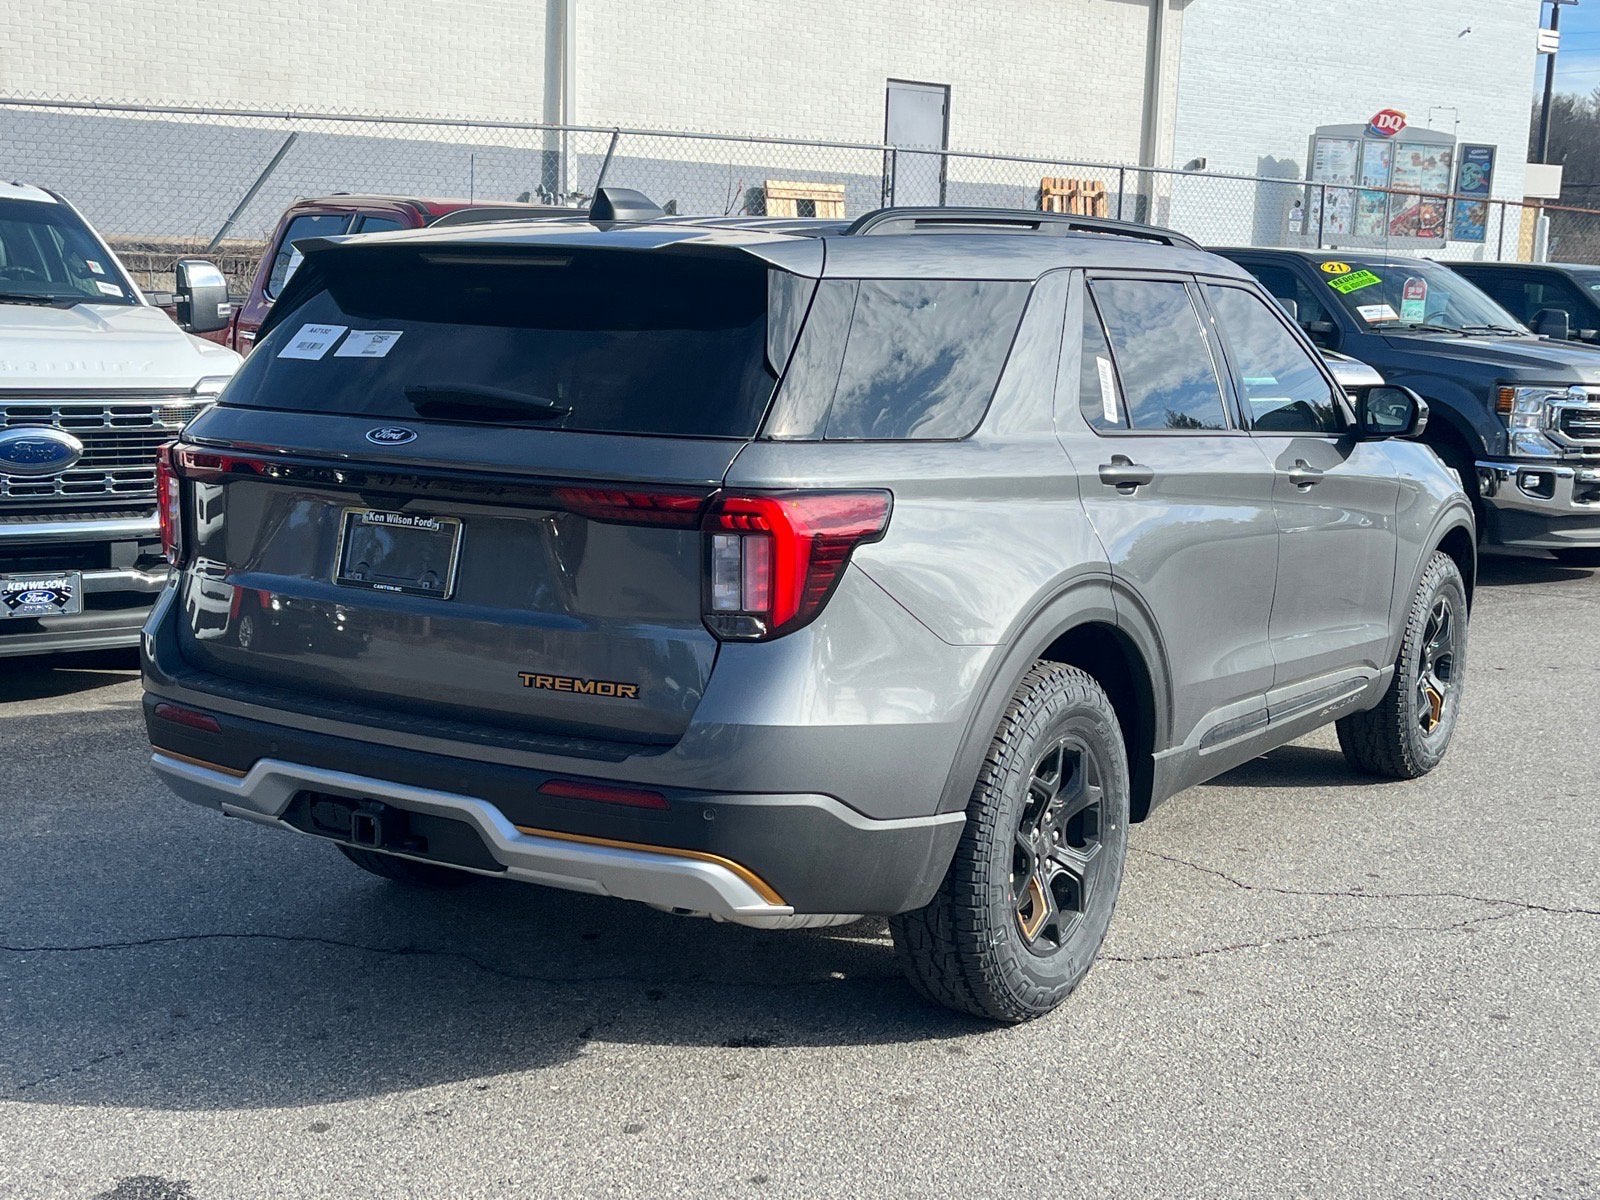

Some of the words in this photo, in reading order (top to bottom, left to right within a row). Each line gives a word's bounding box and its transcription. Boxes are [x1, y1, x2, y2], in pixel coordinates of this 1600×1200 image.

[1377, 114, 1402, 131] DQ
[1327, 264, 1343, 272] 21
[1332, 271, 1369, 287] REDUCED
[375, 428, 406, 440] Ford
[368, 512, 385, 522] Ken
[386, 513, 412, 525] Wilson
[414, 516, 432, 527] Ford
[24, 592, 50, 604] Ford
[518, 672, 639, 699] TREMOR
